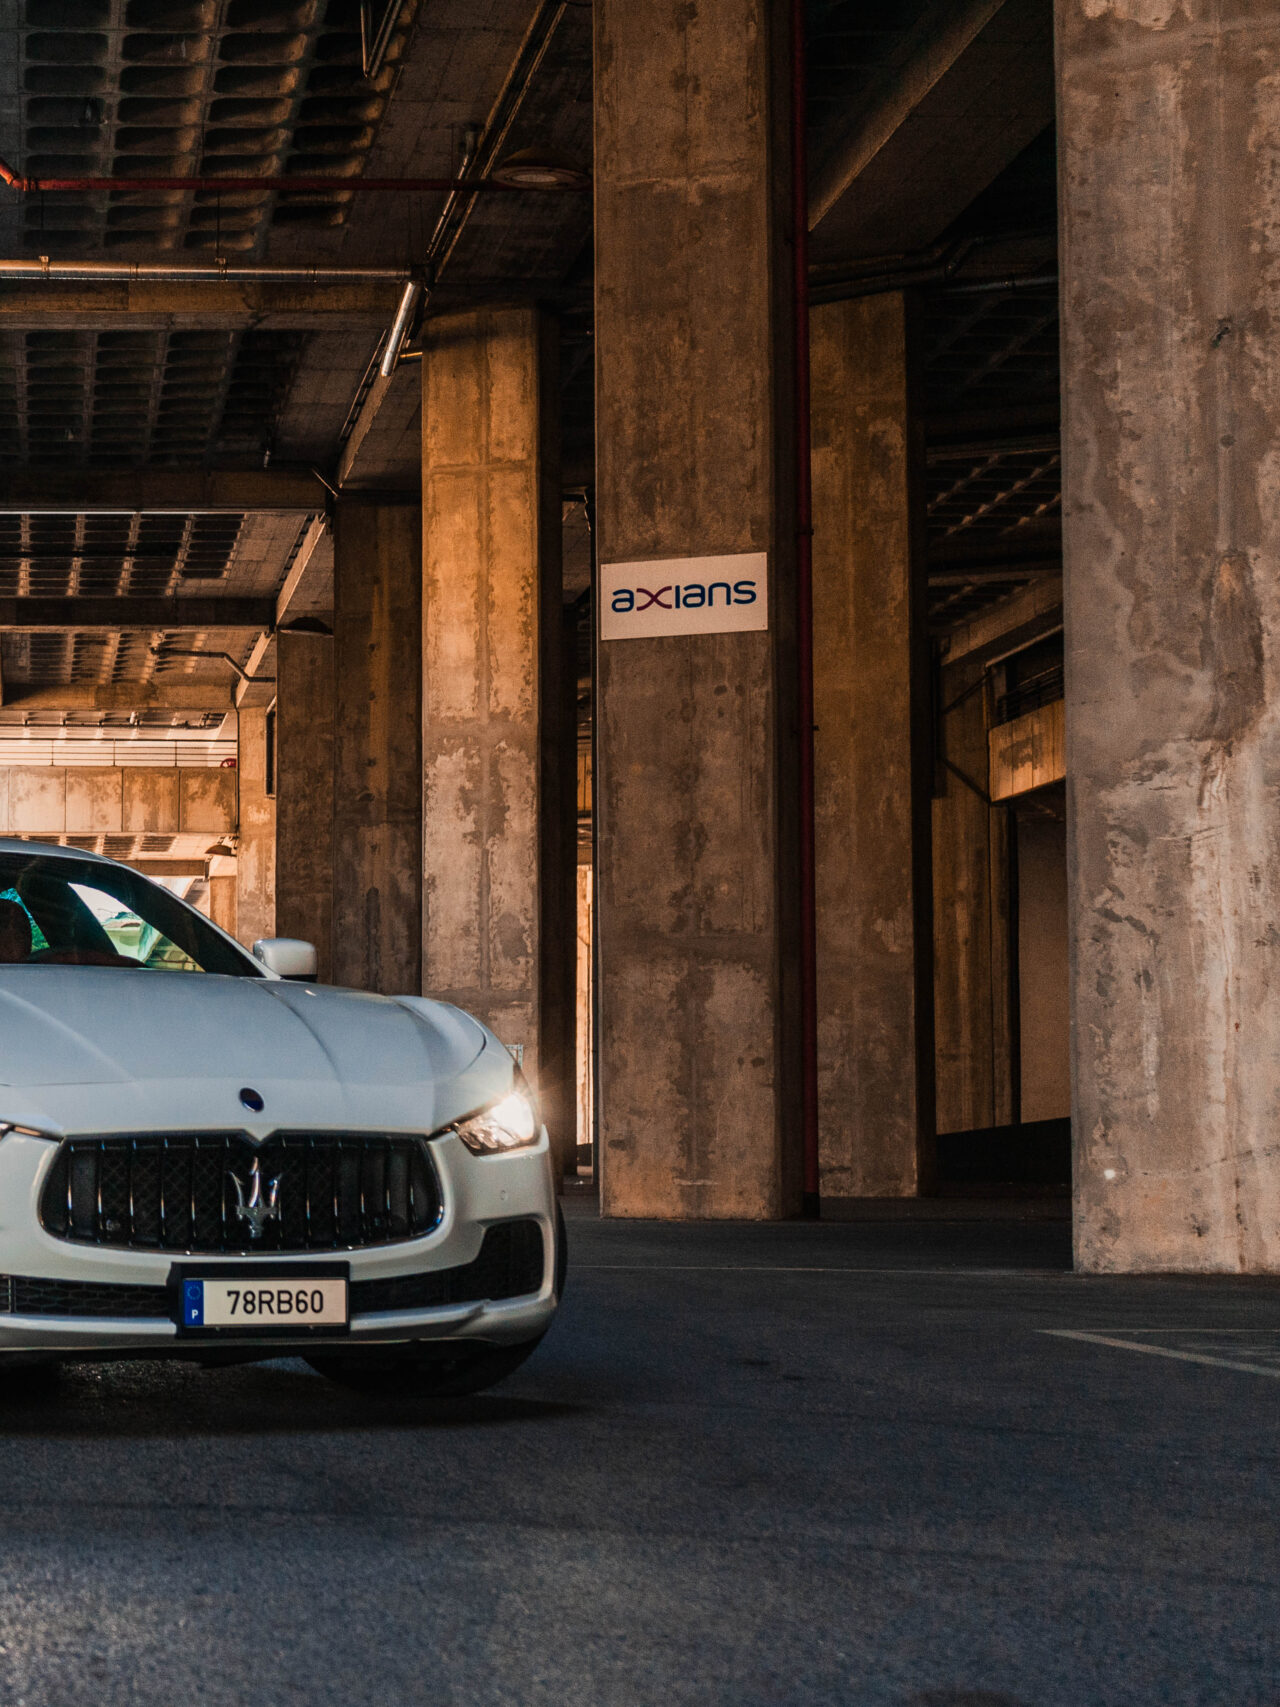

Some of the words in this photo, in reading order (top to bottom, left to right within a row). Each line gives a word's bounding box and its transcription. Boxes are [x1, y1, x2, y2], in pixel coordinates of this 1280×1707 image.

[611, 580, 757, 612] axians
[191, 1309, 199, 1319] P
[226, 1290, 324, 1315] 78RB60
